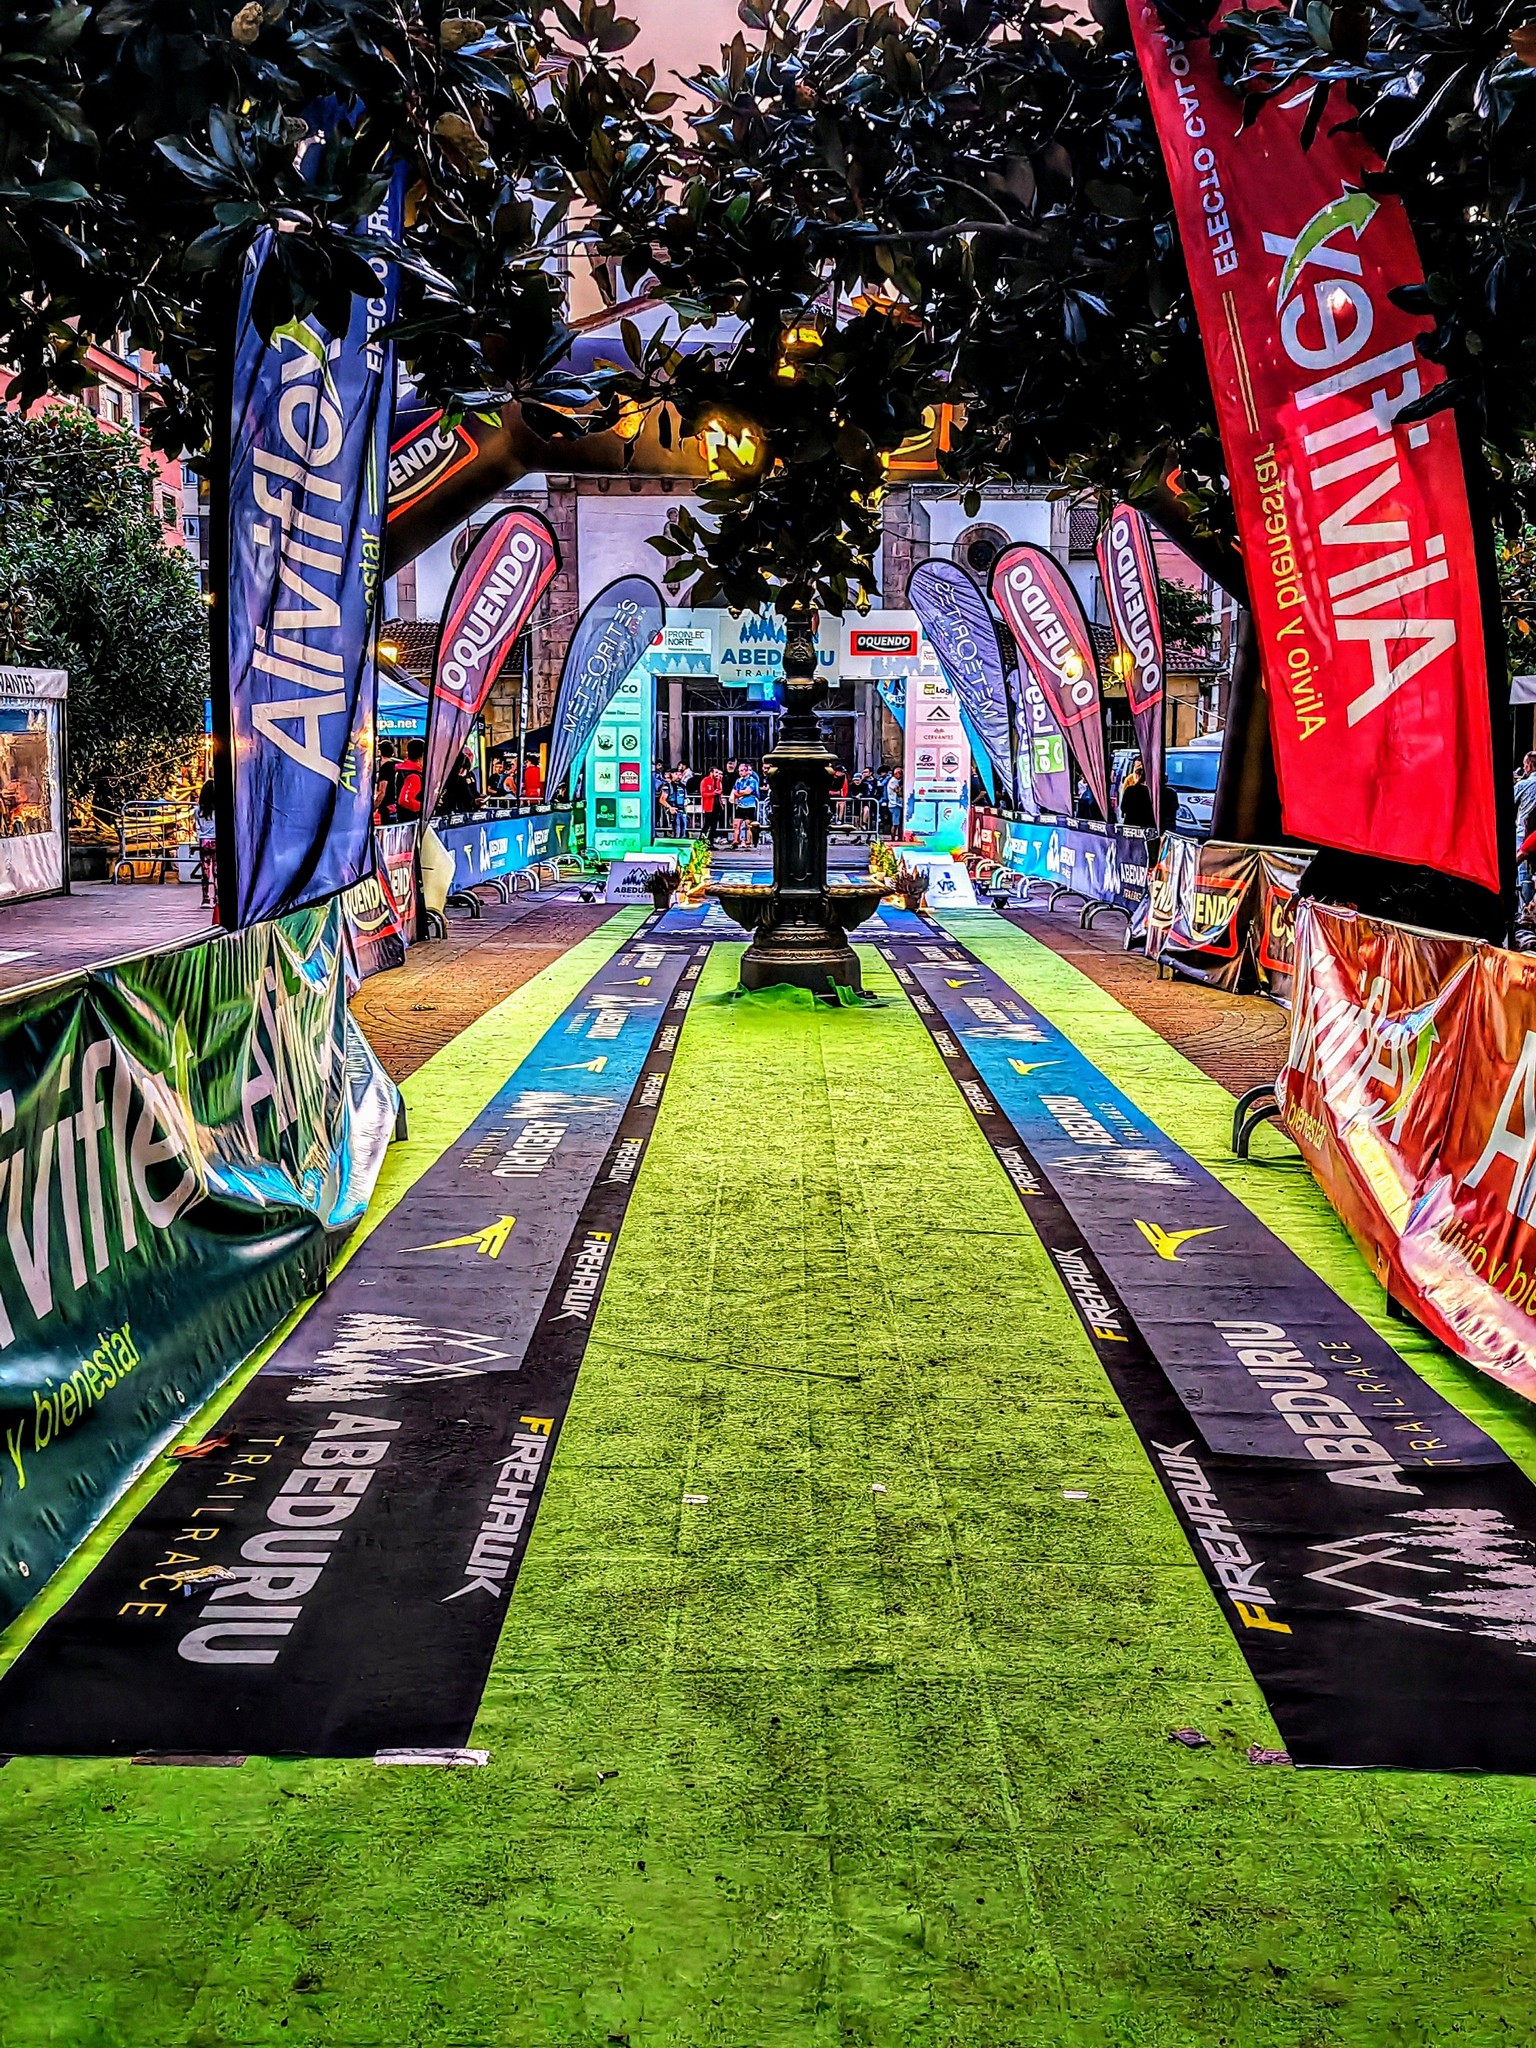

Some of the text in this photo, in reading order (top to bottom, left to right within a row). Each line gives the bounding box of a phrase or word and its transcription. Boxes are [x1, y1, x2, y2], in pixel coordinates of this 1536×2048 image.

[388, 425, 455, 494] ENDO
[441, 531, 538, 691] OQUENDO
[668, 639, 694, 647] NORTE
[720, 649, 835, 666] ABEDU
[858, 636, 910, 651] OQUENDO
[634, 1072, 666, 1109] FIREHAWK
[960, 1080, 997, 1116] FIREHAWK
[1039, 1094, 1123, 1147] ABEDURIU
[491, 1121, 571, 1179] ABEDURIU
[600, 1137, 645, 1186] FIREHAWK
[995, 1145, 1045, 1197] FIREHAWK
[547, 1230, 613, 1322] FIREHAWK
[1050, 1246, 1130, 1343] FIREHAWK
[6, 1320, 143, 1491] y bienestar
[1212, 1319, 1425, 1497] ABEDURIU
[177, 1411, 403, 1665] ABEDURIU
[440, 1414, 556, 1603] FIREHAWK
[1150, 1438, 1294, 1636] FIREHAWK
